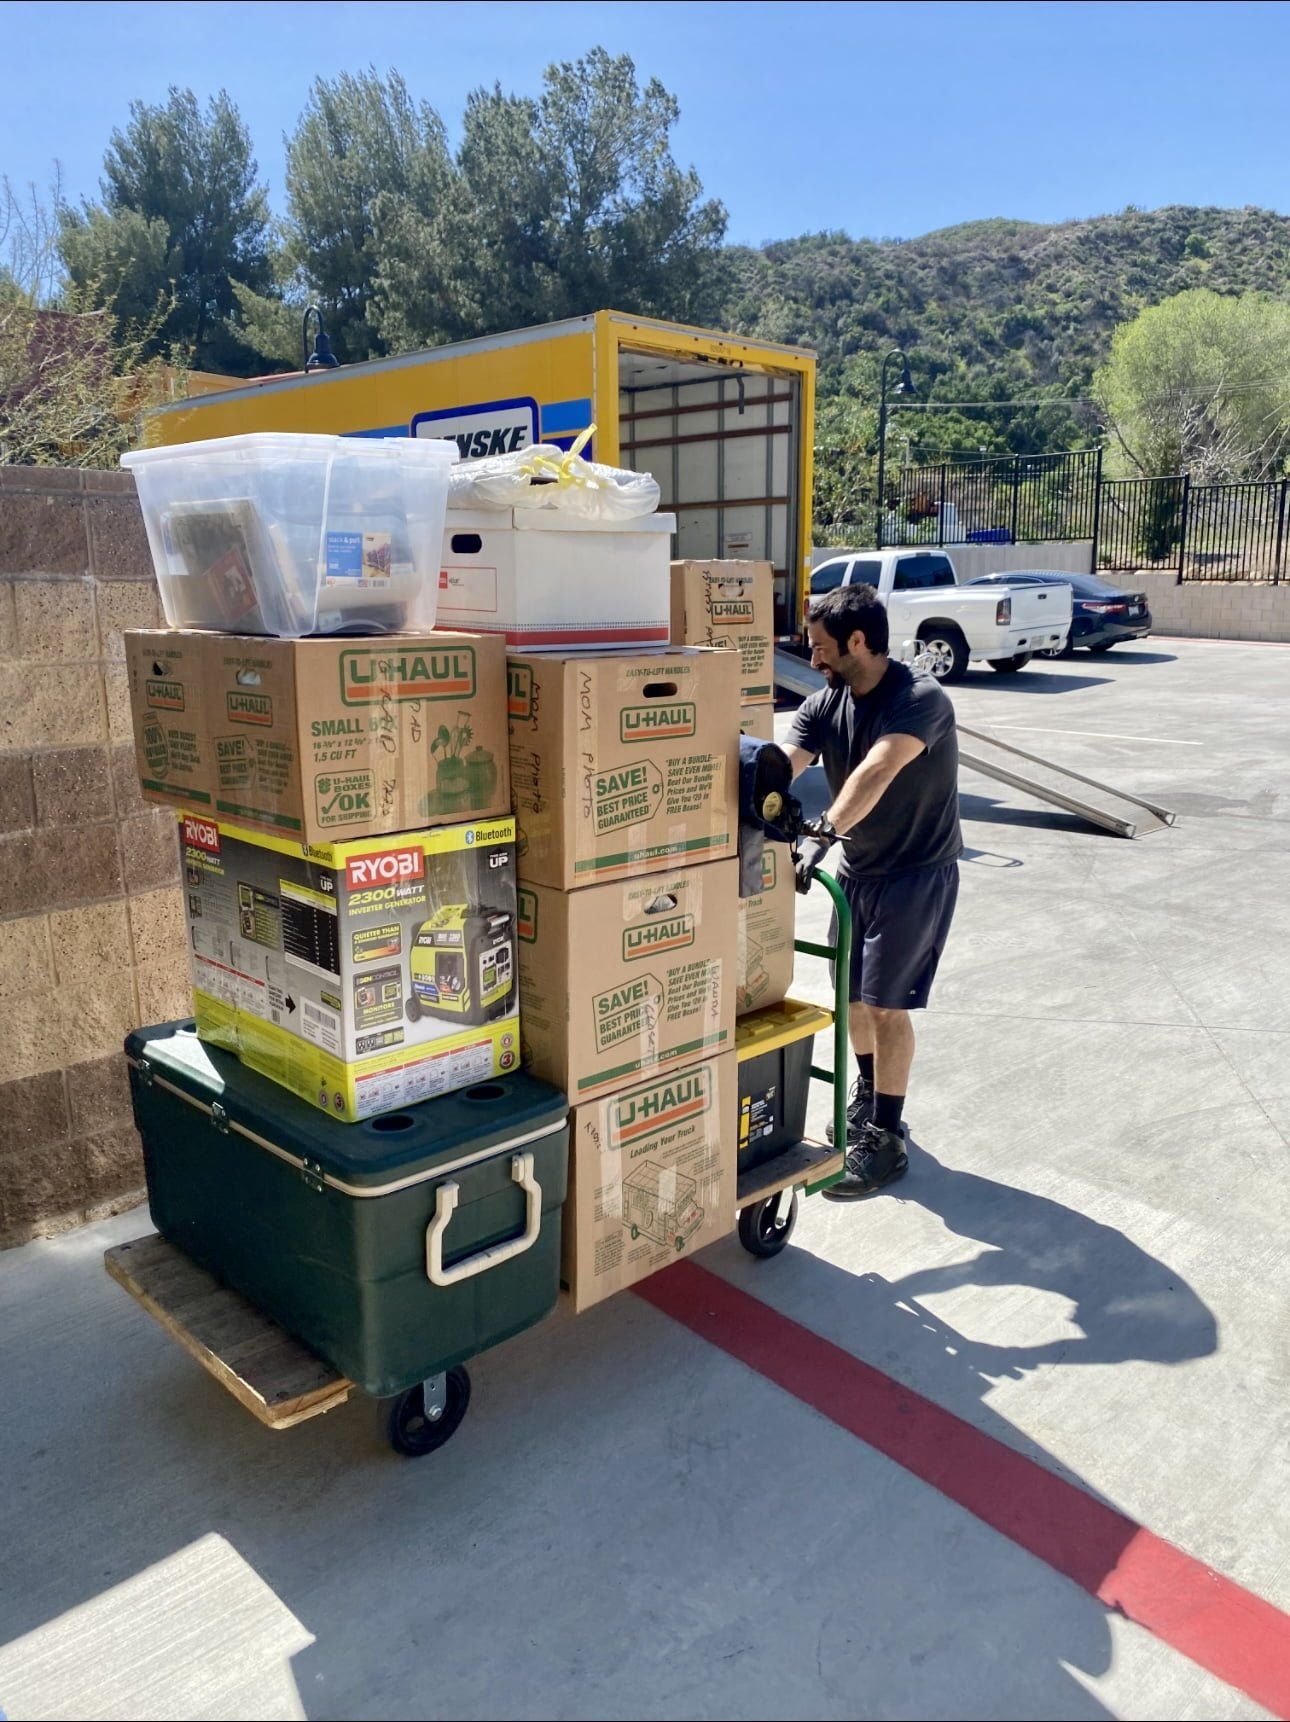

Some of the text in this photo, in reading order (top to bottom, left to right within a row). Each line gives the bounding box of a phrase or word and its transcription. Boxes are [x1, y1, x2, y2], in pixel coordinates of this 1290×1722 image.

[431, 425, 528, 459] NSKE
[714, 604, 752, 616] U-HAUL
[350, 655, 468, 684] U-HAUL
[665, 666, 691, 674] HANDLES
[149, 684, 183, 700] U-HAUL
[229, 696, 269, 715] U-HAUL
[580, 671, 592, 732] MOM
[311, 717, 364, 738] SMALL
[626, 710, 691, 729] U-HAUL
[330, 750, 342, 760] CU
[344, 748, 357, 760] FT
[668, 768, 684, 776] SAVE
[684, 766, 700, 774] EVEN
[333, 775, 370, 785] U-HAUL
[334, 782, 372, 792] BOXES
[596, 766, 648, 796] SAVE!
[686, 784, 698, 794] and
[340, 792, 370, 811] OK
[597, 792, 648, 818] BEST PRICE
[667, 804, 682, 814] FREE
[320, 816, 336, 824] FOR
[598, 804, 650, 830] GUARANTEED
[184, 820, 218, 846] RYOBI
[476, 828, 512, 842] Bluetooth
[186, 847, 206, 862] 2300
[308, 848, 333, 863] Bluetooth
[634, 846, 678, 860] uhaul.com
[350, 852, 419, 884] RYOBI
[490, 856, 508, 868] UP
[320, 880, 334, 892] UP
[348, 884, 424, 907] 2300 WATT
[348, 895, 426, 916] INVERTER GENERATOR
[354, 929, 380, 940] QUIETER
[628, 920, 690, 948] U-HAUL
[668, 976, 684, 987] SAVE
[685, 970, 700, 982] EVEN
[598, 980, 648, 1014] SAVE!
[686, 990, 698, 998] and
[667, 1010, 682, 1022] FREE
[600, 1016, 622, 1034] BEST
[616, 1077, 705, 1128] U-HAUL
[630, 1124, 696, 1159] Loading Your Truck
